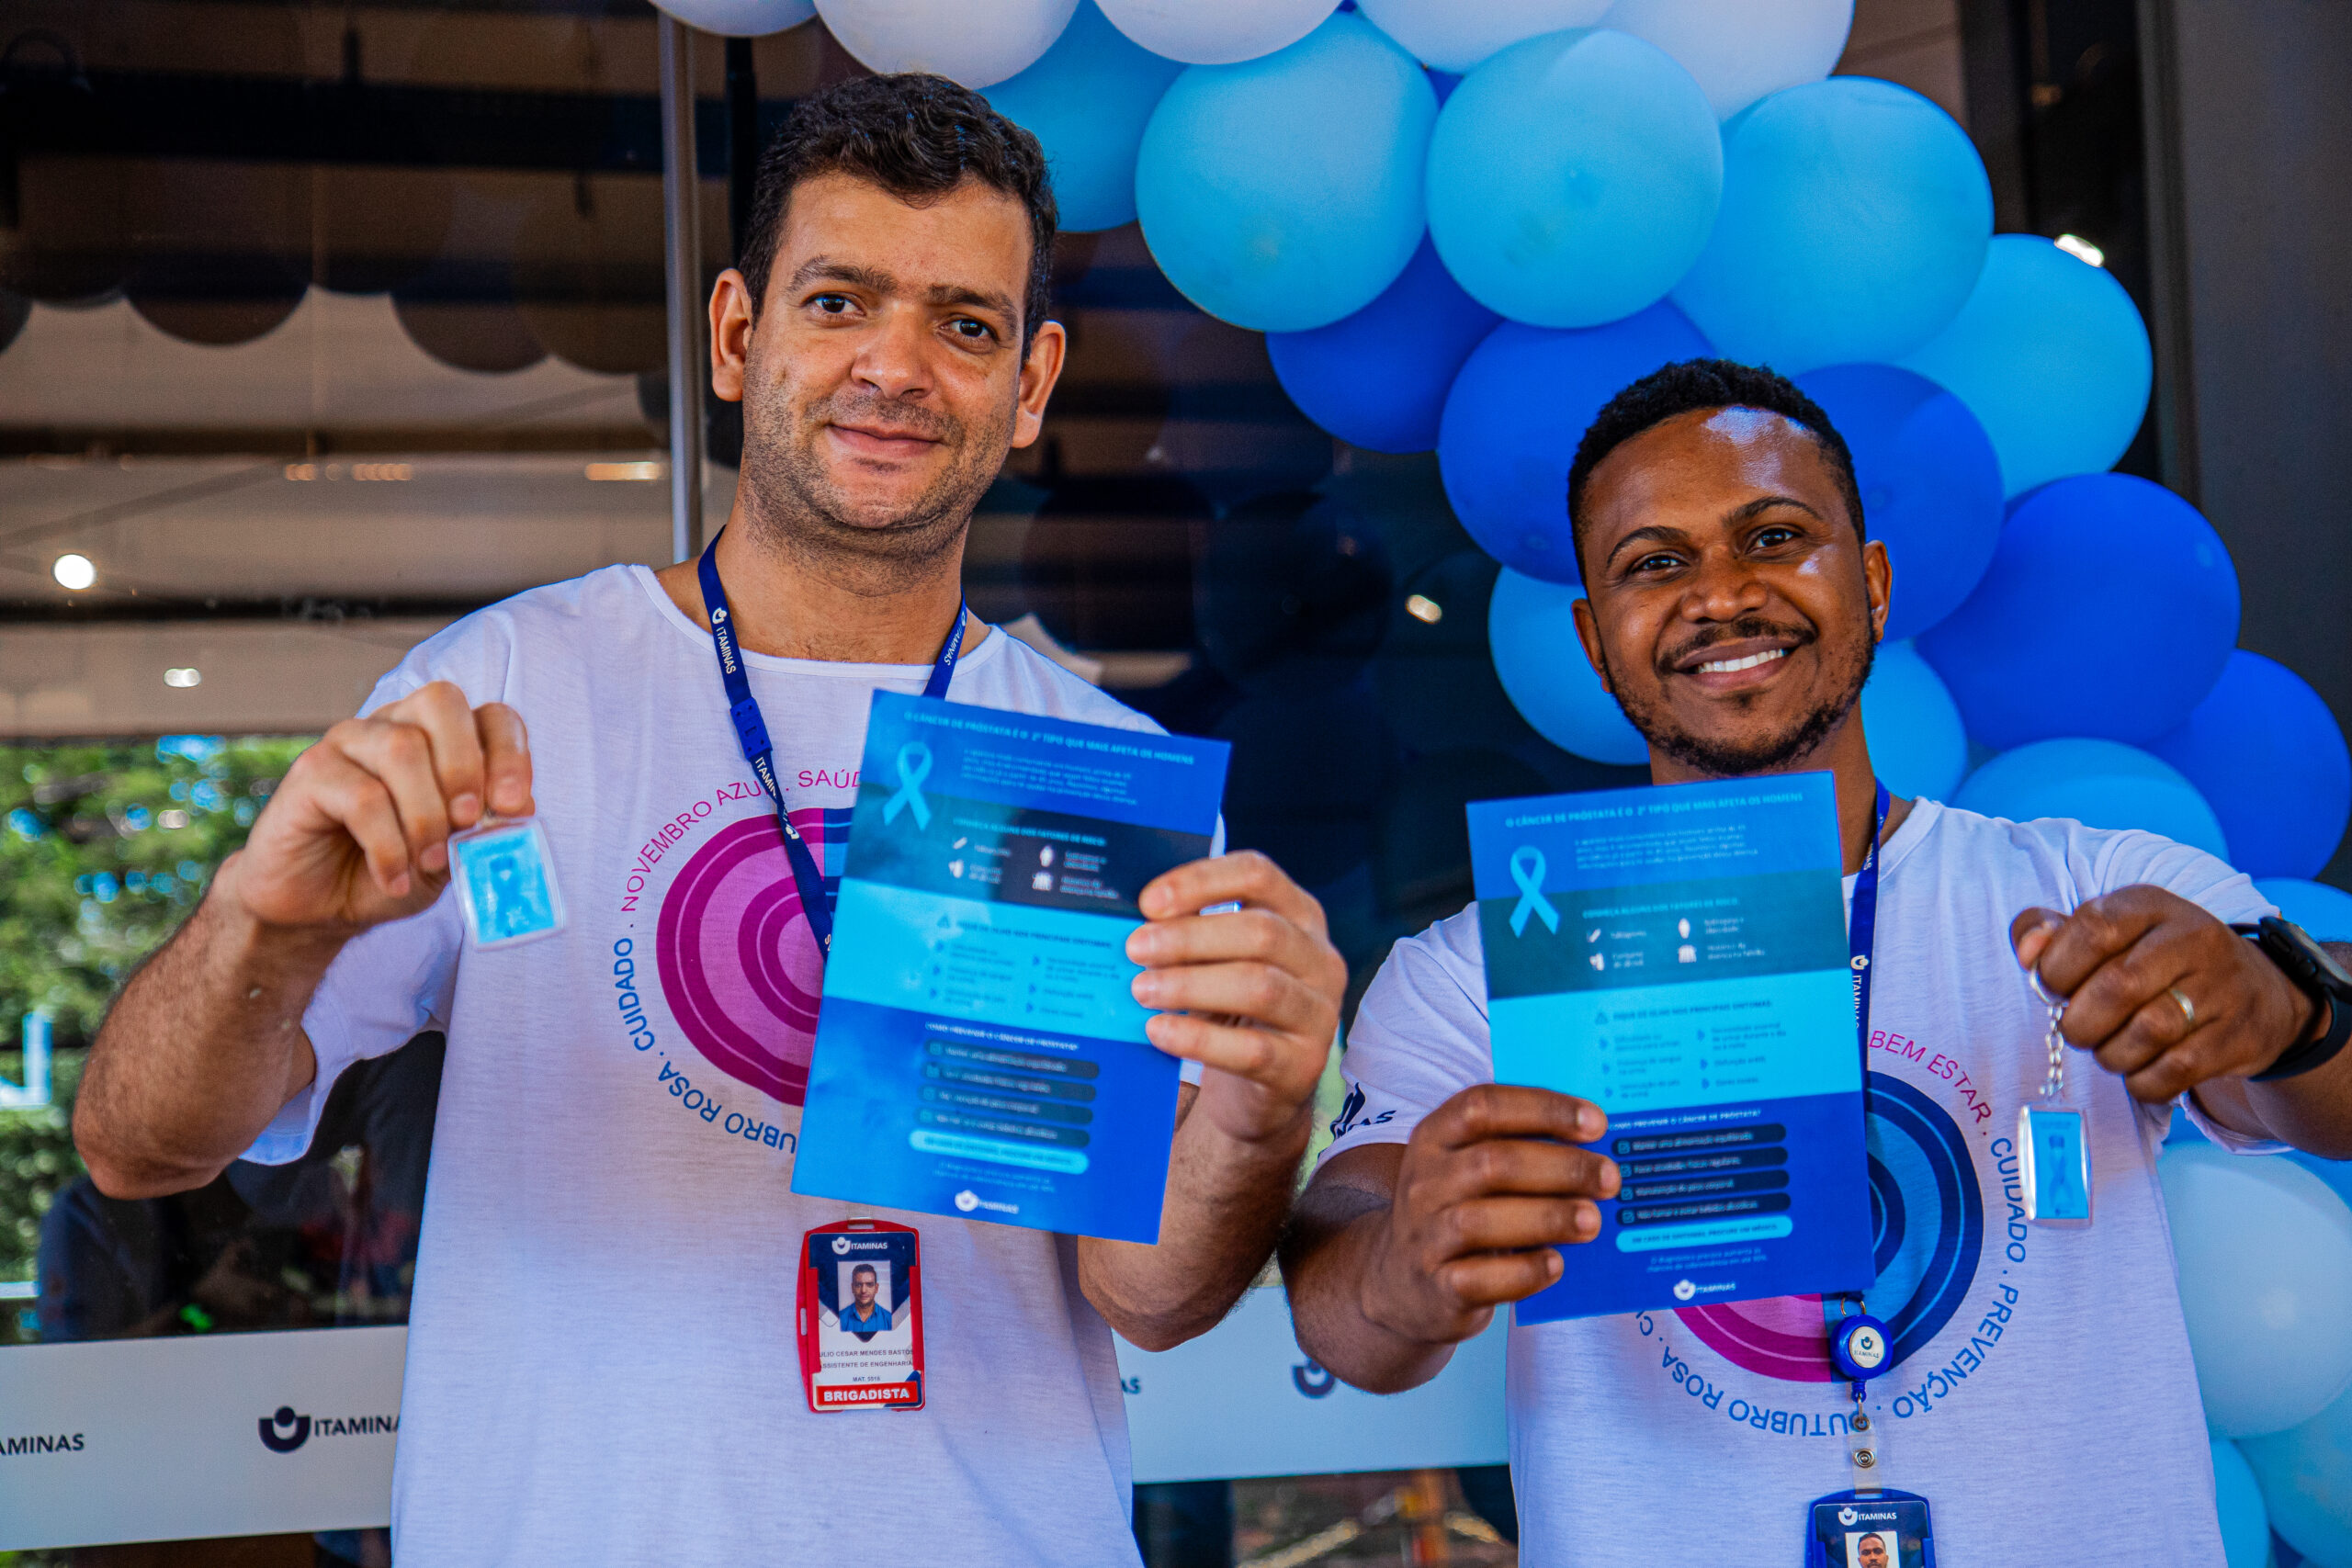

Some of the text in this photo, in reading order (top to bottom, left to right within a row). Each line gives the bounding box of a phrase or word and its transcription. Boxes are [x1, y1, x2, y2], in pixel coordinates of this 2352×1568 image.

[716, 626, 736, 674] ITAMINAS
[755, 757, 777, 797] ITAMIN
[621, 769, 861, 912] NOVEMBRO AZU SAÚD
[1852, 975, 1861, 1028] ITAMIN
[614, 938, 797, 1154] UBRO ROSA CUIDADO
[1869, 1030, 1927, 1063] BEM
[1927, 1054, 1992, 1123] ESTAR
[1990, 1137, 2028, 1263] CUIDADO
[852, 1242, 888, 1250] ITAMINAS
[1892, 1282, 2019, 1419] PREVENÇÃO
[823, 1388, 910, 1402] BRIGADISTA
[1660, 1346, 1724, 1411] ROSA
[1858, 1512, 1896, 1521] ITAMINAS
